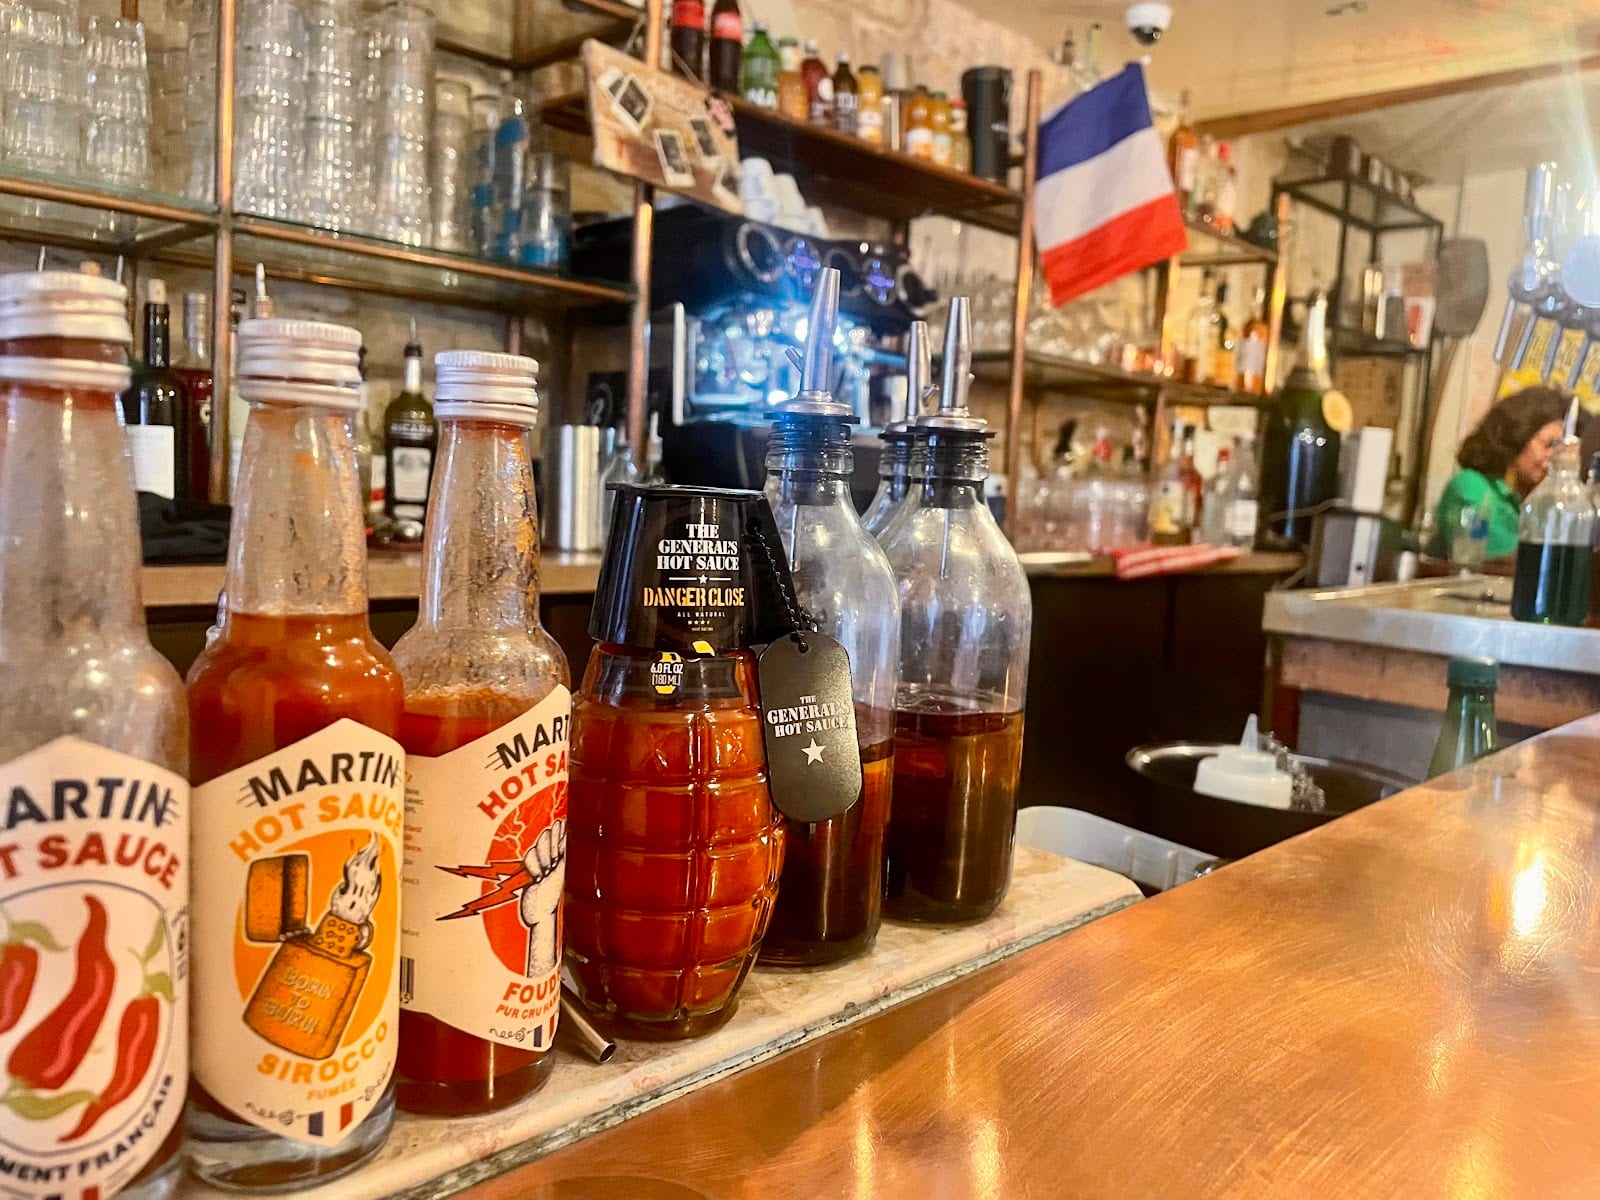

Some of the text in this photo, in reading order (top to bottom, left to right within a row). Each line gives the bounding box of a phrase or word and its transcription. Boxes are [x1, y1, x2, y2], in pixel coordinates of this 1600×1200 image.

[686, 523, 719, 539] THE
[658, 539, 738, 555] GENERAL'S
[656, 555, 740, 571] HOT SAUCE
[643, 587, 745, 607] DANGER CLOSE
[663, 663, 673, 674] FL
[673, 663, 684, 675] OZ
[800, 695, 817, 704] THE
[774, 714, 847, 738] HOT SAUCE
[248, 751, 400, 807] MARTIN
[477, 761, 538, 820] HOT
[0, 778, 171, 830] ARTIN
[228, 802, 306, 863] HOT
[318, 793, 402, 837] SAUCE
[38, 831, 180, 890] SAUCE
[282, 967, 335, 999] BORN
[290, 991, 311, 1010] TO
[496, 1004, 520, 1019] PUR
[521, 1006, 543, 1020] CRU
[262, 998, 321, 1035] BURN
[256, 1020, 388, 1085] SIROCCO
[77, 1074, 174, 1177] FRANÇAIS
